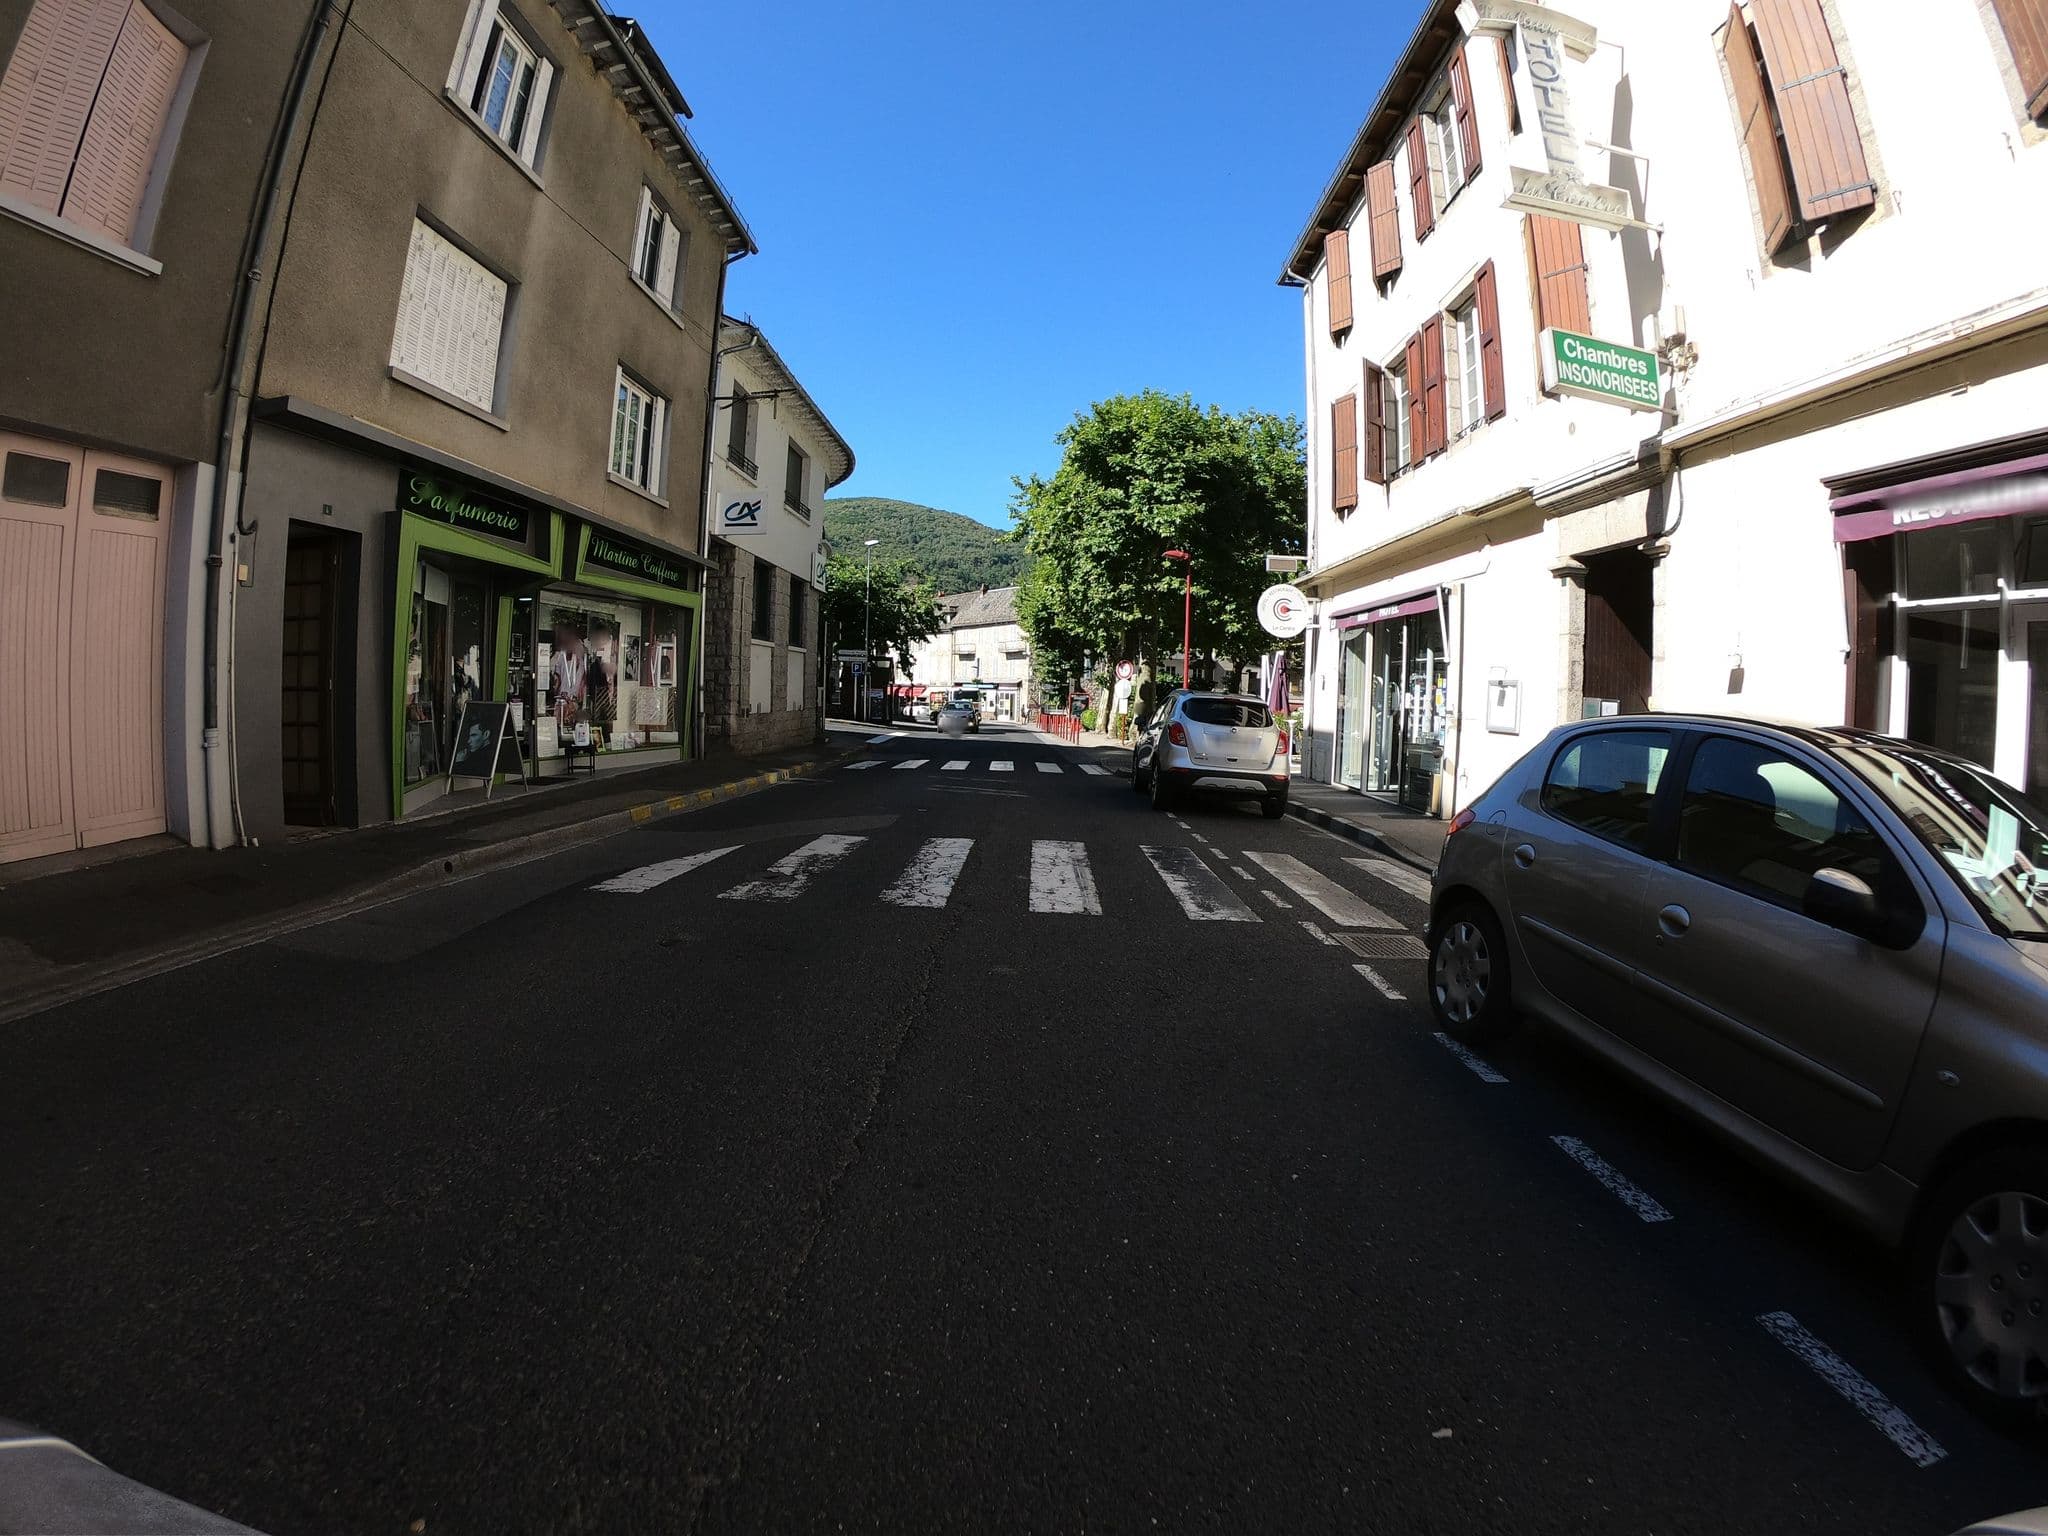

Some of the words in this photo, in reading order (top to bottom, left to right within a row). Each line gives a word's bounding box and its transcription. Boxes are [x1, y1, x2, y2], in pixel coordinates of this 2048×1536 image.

[1563, 338, 1648, 375] Chambres
[1558, 360, 1657, 401] INSONORISEES
[591, 536, 639, 569] Martine
[640, 551, 680, 583] Coiffure
